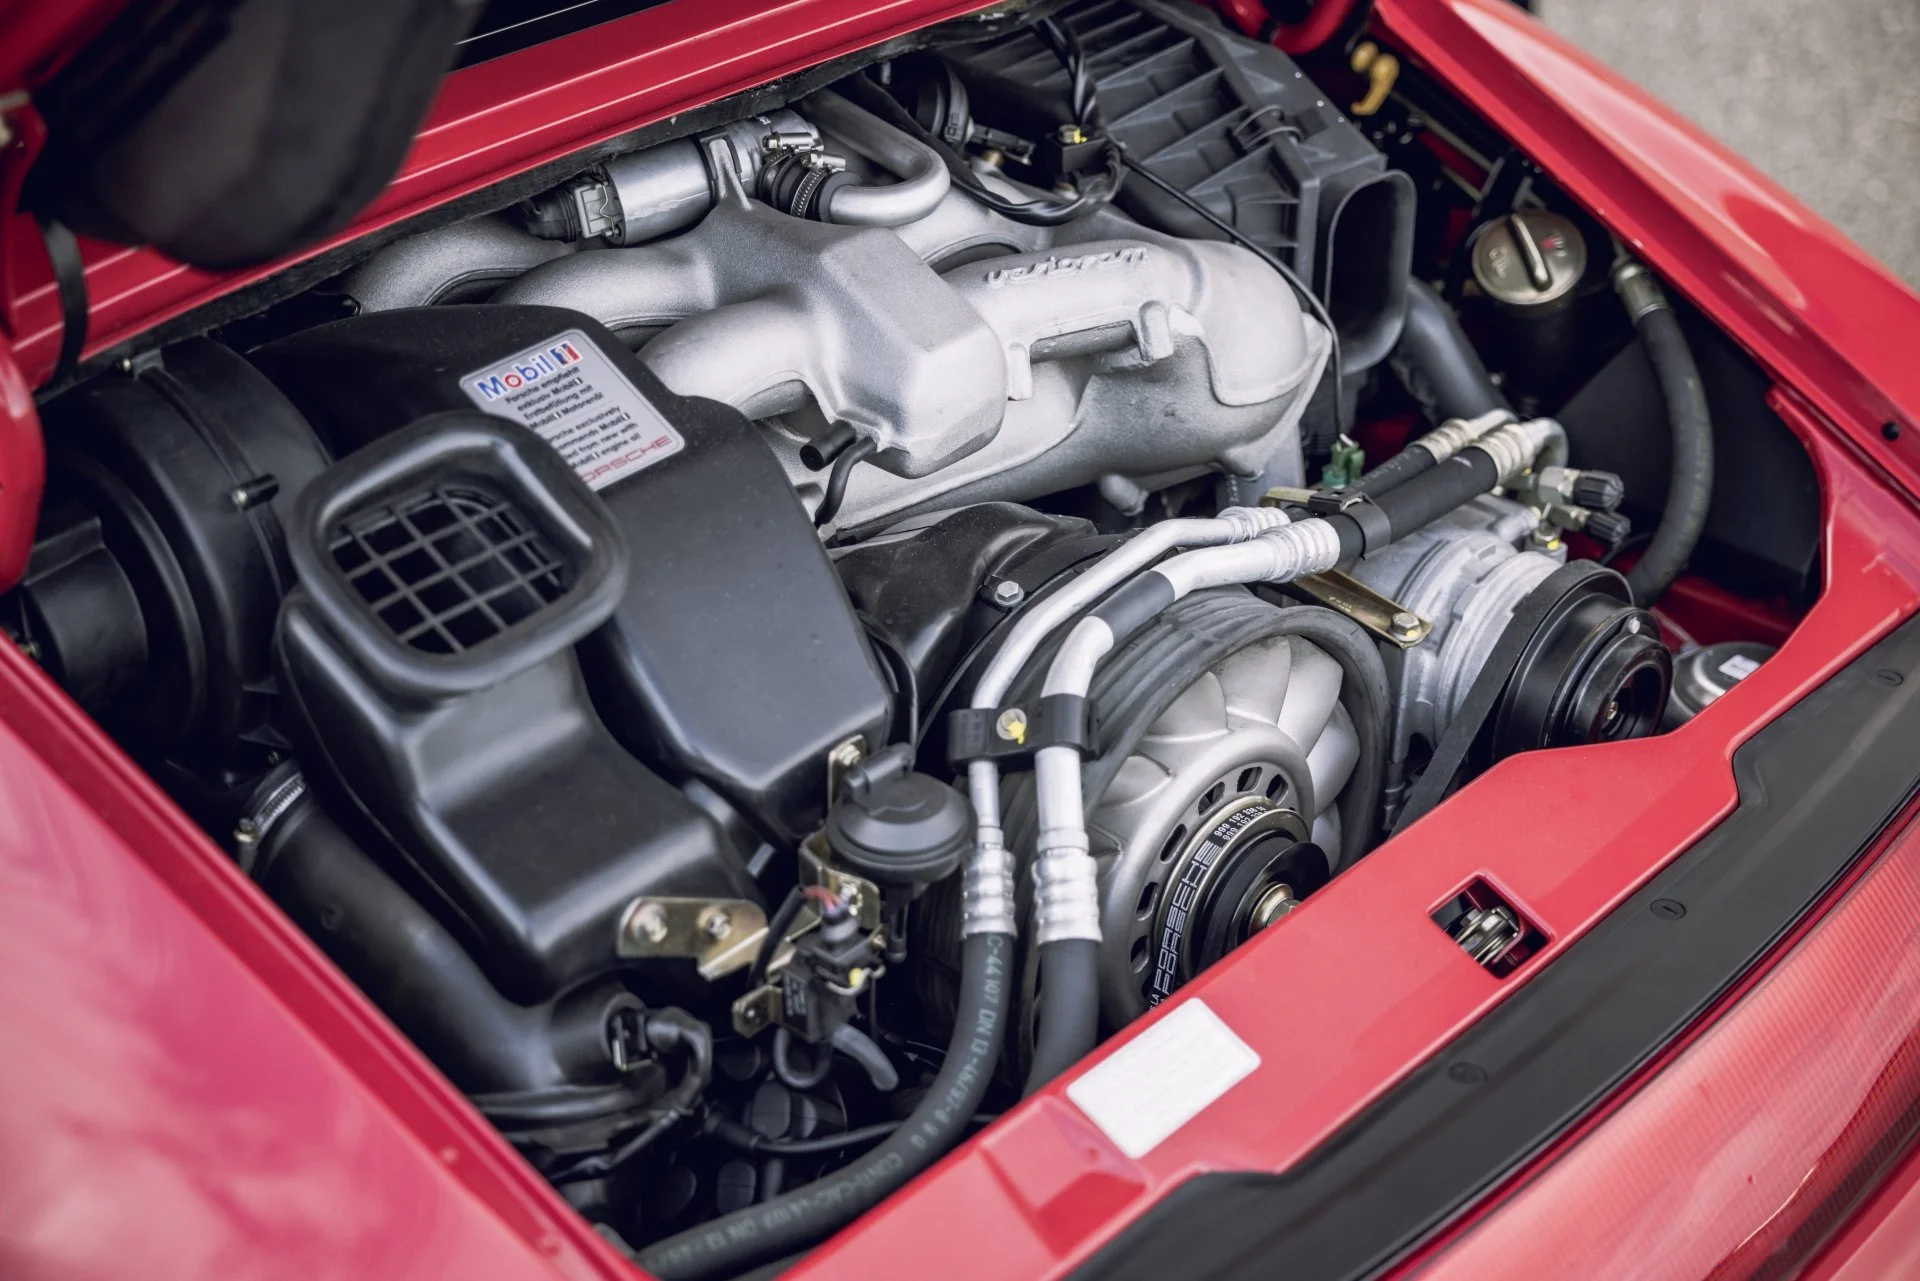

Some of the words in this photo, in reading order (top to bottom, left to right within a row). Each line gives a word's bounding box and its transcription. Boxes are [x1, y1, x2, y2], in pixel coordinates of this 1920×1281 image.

[477, 354, 554, 399] Mobil
[580, 384, 594, 395] mit
[505, 386, 540, 404] Porsche
[576, 406, 621, 430] exclusively
[578, 441, 599, 453] from
[600, 432, 619, 443] new
[620, 422, 639, 434] with
[601, 440, 629, 457] engine
[630, 432, 642, 443] oil
[582, 435, 673, 482] ORSCHE
[1154, 840, 1214, 991] PORSCHE
[1214, 823, 1231, 837] 999
[1229, 812, 1245, 823] 192
[1162, 844, 1222, 995] PORSCHE
